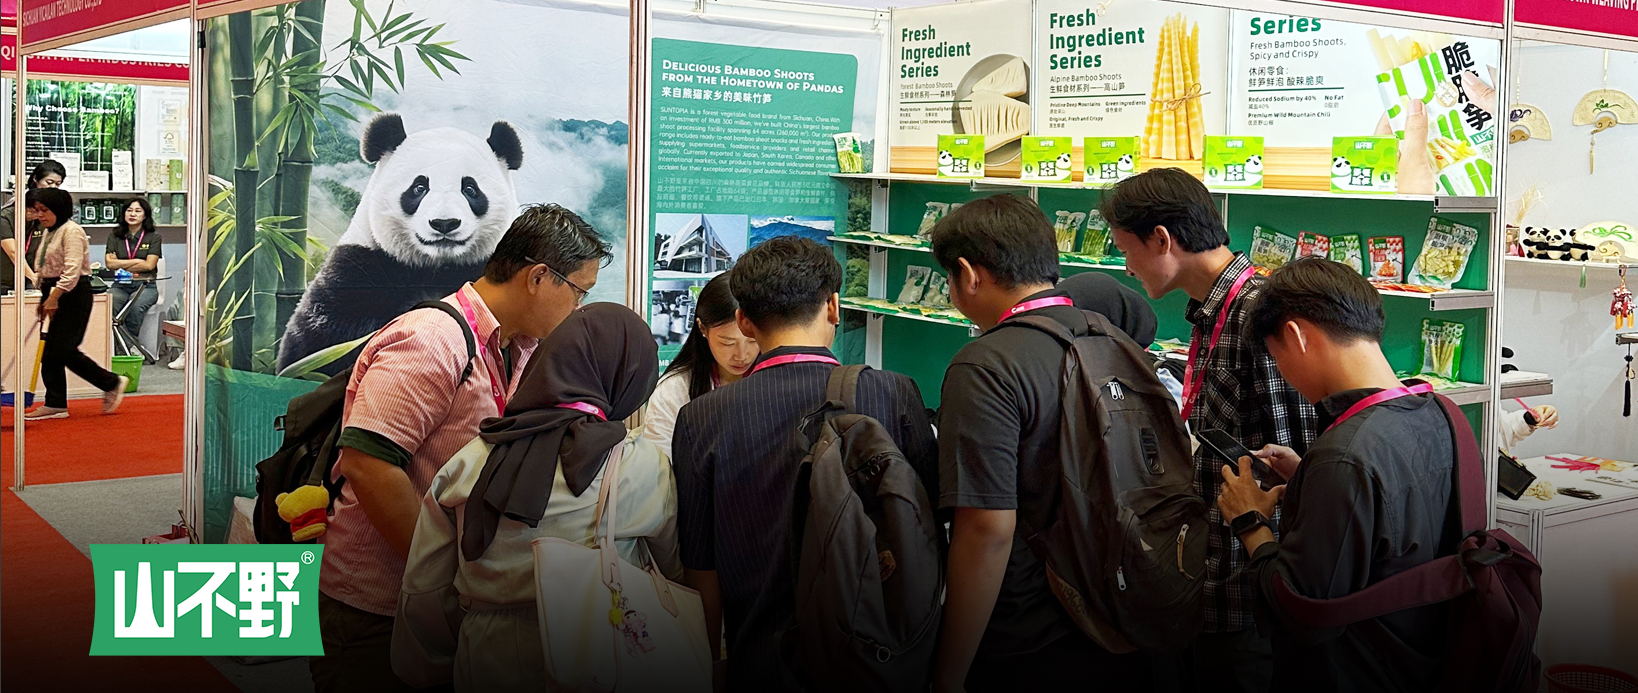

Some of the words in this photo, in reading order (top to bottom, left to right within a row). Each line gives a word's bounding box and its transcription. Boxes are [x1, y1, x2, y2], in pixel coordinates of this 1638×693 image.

[1050, 8, 1095, 29] Fresh
[1250, 16, 1321, 36] Series
[902, 25, 936, 42] Fresh
[1050, 27, 1144, 52] Ingredient
[901, 41, 971, 63] Ingredient
[1250, 41, 1272, 50] Fresh
[1275, 40, 1311, 48] Bamboo
[1313, 38, 1346, 47] Shoots,
[1050, 51, 1102, 70] Series
[1250, 52, 1272, 61] Spicy
[1274, 50, 1290, 58] and
[1292, 50, 1319, 59] Crispy
[901, 62, 939, 78] Series
[662, 86, 772, 104] 来自熊猫家乡的美味竹笋
[669, 115, 700, 123] investment
[677, 124, 706, 132] processing
[733, 134, 754, 142] bamboo
